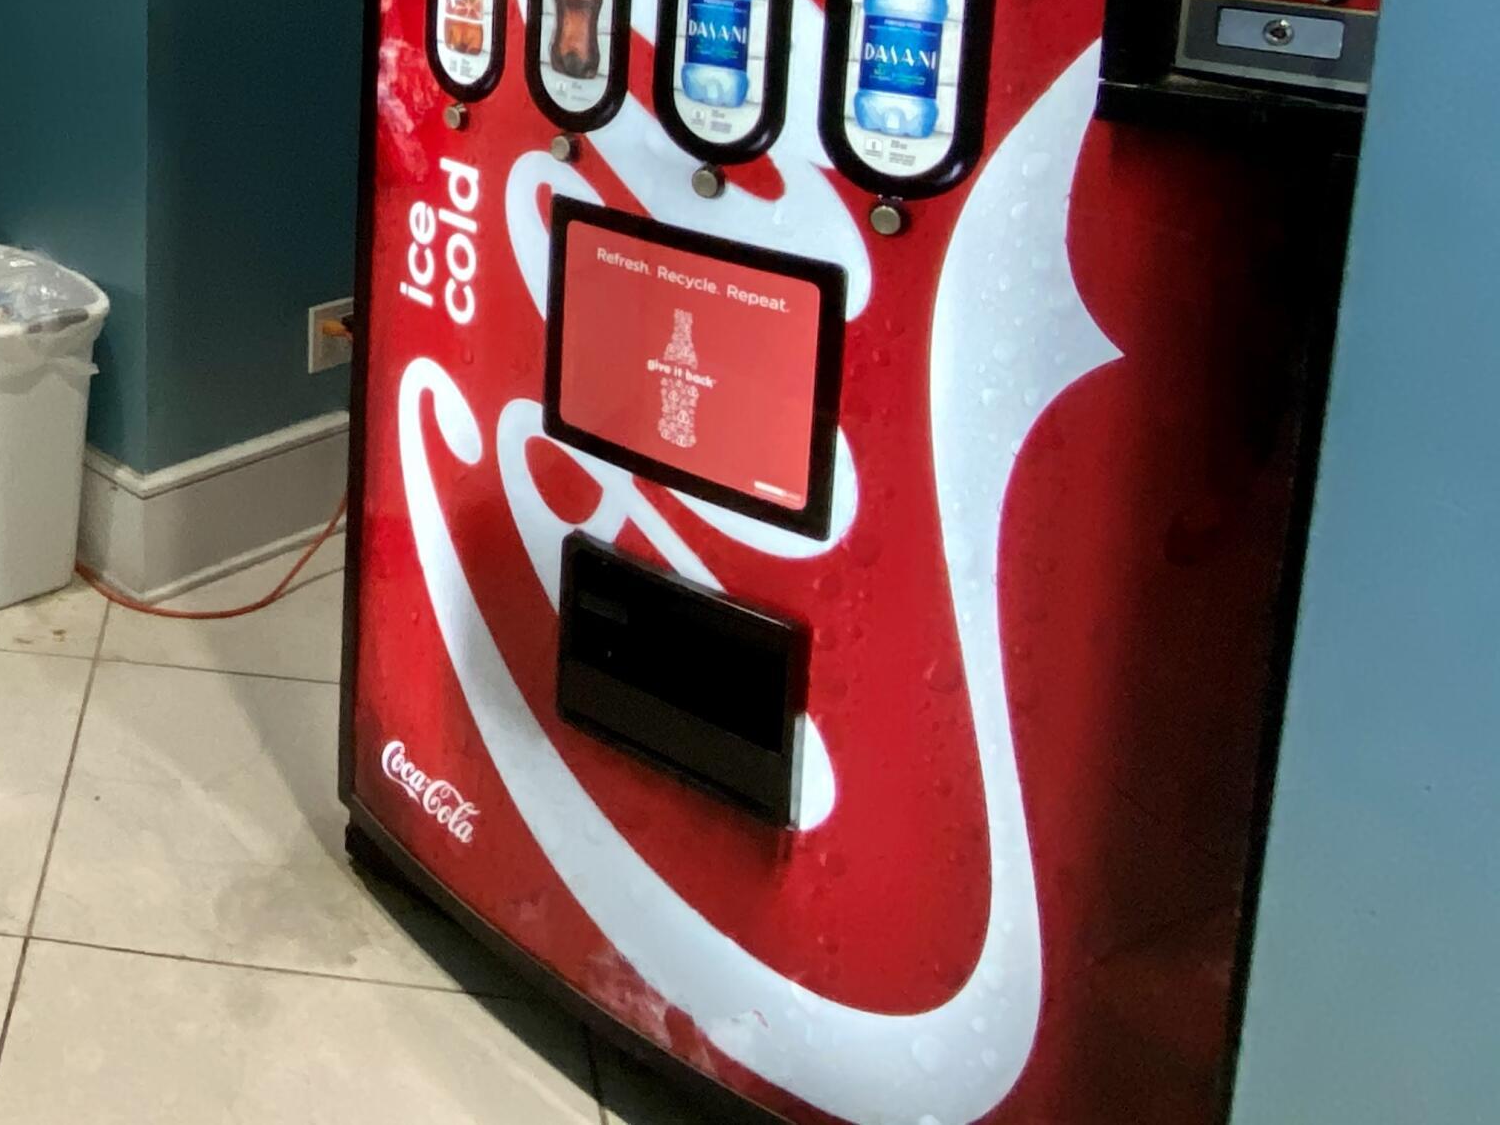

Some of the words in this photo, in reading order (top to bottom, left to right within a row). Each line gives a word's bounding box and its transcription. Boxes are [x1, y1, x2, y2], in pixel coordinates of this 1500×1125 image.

[688, 18, 747, 44] DASANI
[864, 42, 937, 71] DASANI
[400, 200, 436, 307] ice
[440, 157, 479, 324] cold
[597, 247, 652, 275] Refresh.
[657, 266, 721, 295] Recycle.
[726, 284, 790, 313] Repeat.
[646, 359, 671, 374] give
[380, 740, 481, 843] Coca-Cola
